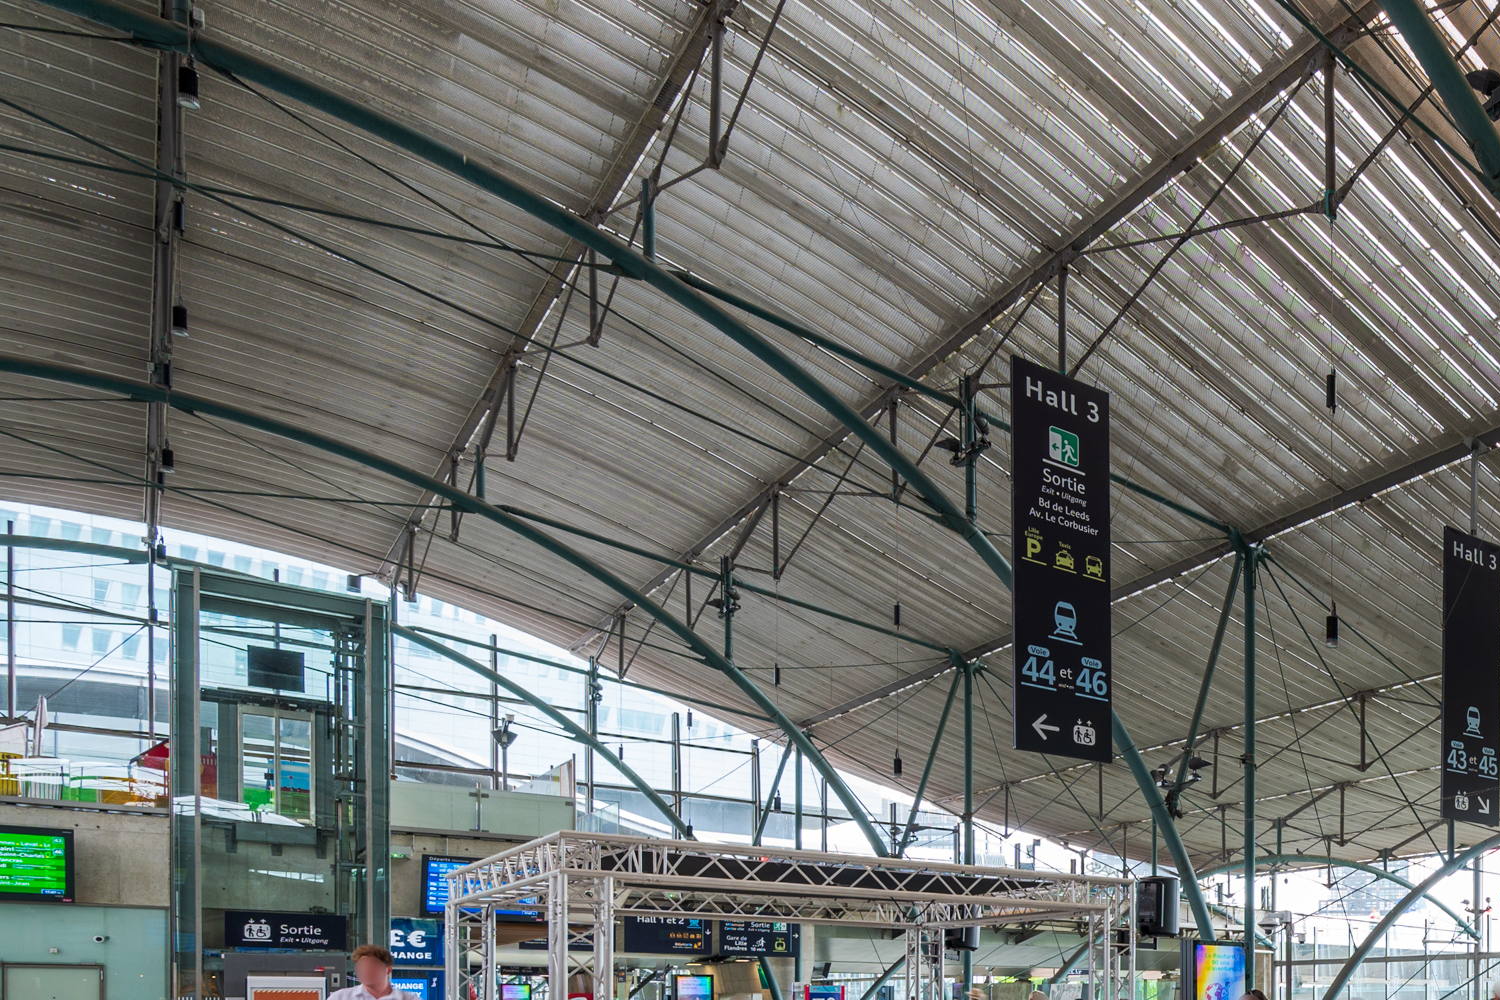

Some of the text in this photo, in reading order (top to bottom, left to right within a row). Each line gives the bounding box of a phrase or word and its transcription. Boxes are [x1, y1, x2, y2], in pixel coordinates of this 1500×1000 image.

[1026, 376, 1099, 423] Hall 3
[1043, 468, 1086, 495] Sortie
[1041, 485, 1087, 507] Exit Uitgang
[1038, 497, 1090, 521] Bd de Leeds
[1028, 526, 1040, 534] Lille
[1029, 507, 1099, 536] Av. Le Corbusier
[1024, 530, 1043, 541] Europe
[1058, 541, 1071, 550] Taxis
[1026, 537, 1041, 558] P
[1453, 540, 1497, 570] Hall 3
[1030, 646, 1047, 656] Voie
[1084, 658, 1099, 668] Voie
[1022, 656, 1108, 696] 44 et 46
[1447, 749, 1498, 776] 43 et 45
[280, 924, 322, 936] Sortie
[637, 915, 685, 925] Hall 1 et 2
[301, 937, 329, 945] Uitgang
